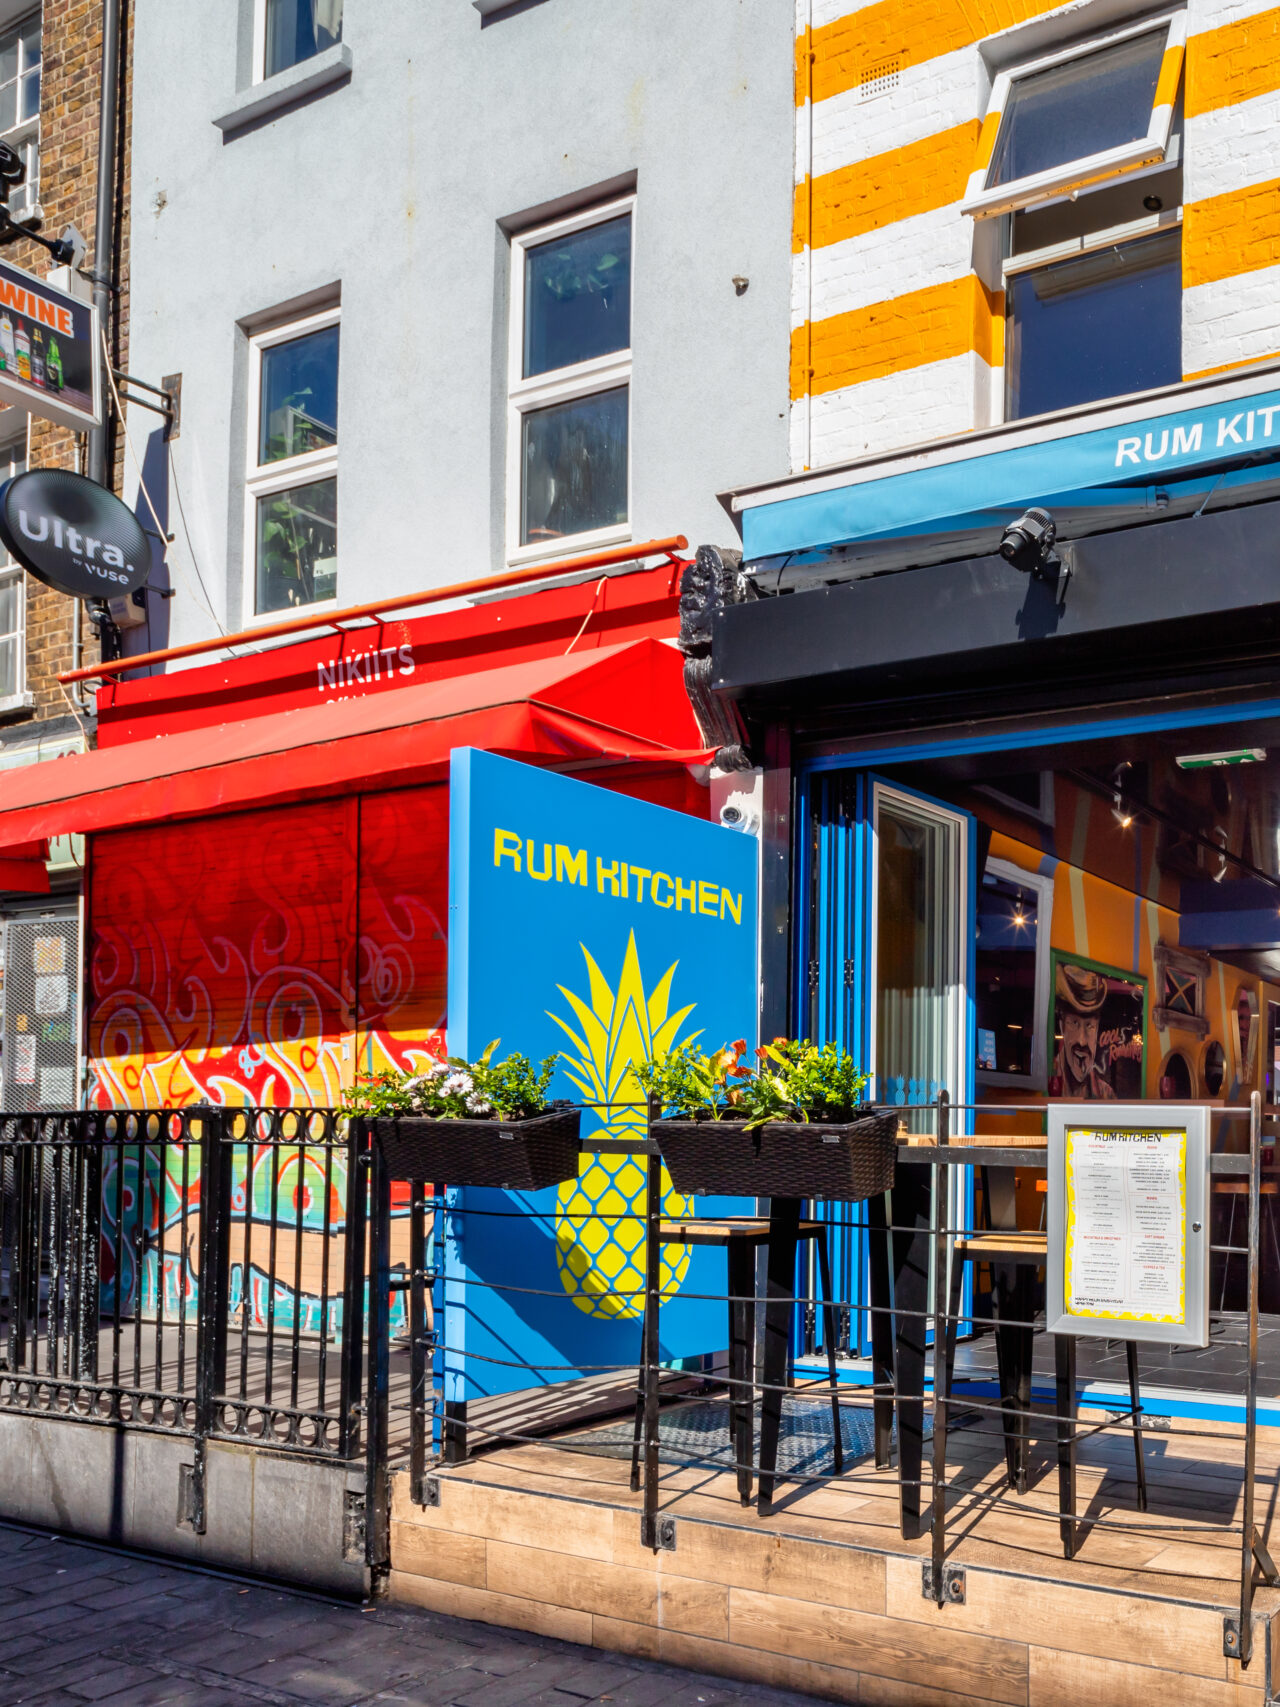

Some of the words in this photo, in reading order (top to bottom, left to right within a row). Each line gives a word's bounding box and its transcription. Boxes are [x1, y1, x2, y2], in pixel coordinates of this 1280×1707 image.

[0, 278, 74, 338] WINE
[1114, 422, 1203, 467] RUM
[18, 509, 135, 573] Ultra.
[494, 827, 588, 887] RUM
[596, 856, 743, 926] KITCHEN
[1118, 1132, 1162, 1143] KITCHEN
